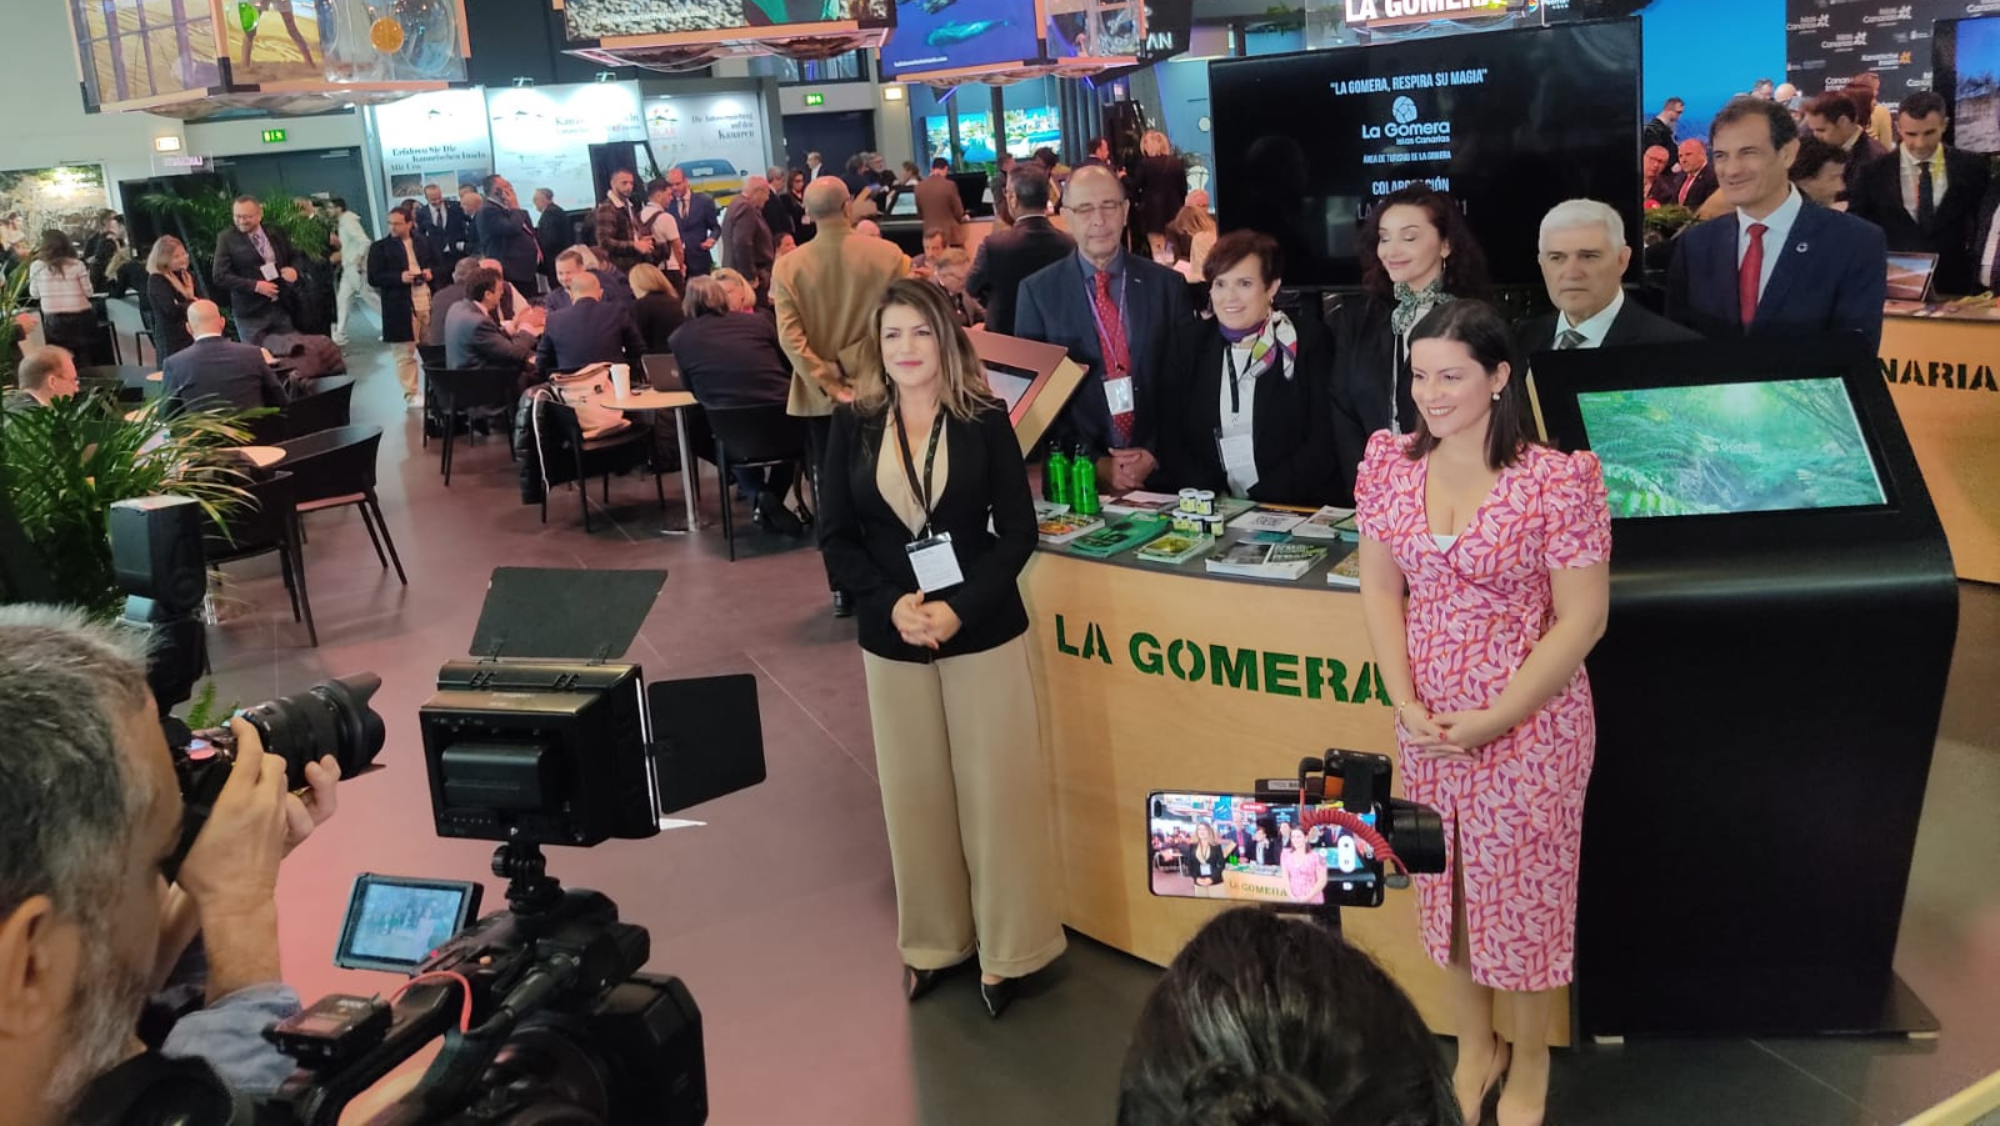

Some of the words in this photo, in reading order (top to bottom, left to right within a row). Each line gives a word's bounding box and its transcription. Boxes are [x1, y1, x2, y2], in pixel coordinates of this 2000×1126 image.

[1330, 80, 1348, 96] "LA
[1348, 77, 1391, 94] GOMERA,
[1392, 73, 1434, 91] RESPIRA
[1434, 71, 1449, 86] SU
[1450, 68, 1488, 86] MAGIA"
[1361, 124, 1381, 139] La
[1384, 121, 1451, 138] Gomera
[1414, 135, 1451, 144] Canarias
[1371, 175, 1450, 196] COLABCIÓN
[1878, 357, 1999, 392] NARIA
[1055, 613, 1113, 665] LA
[1128, 631, 1394, 707] GOMERA
